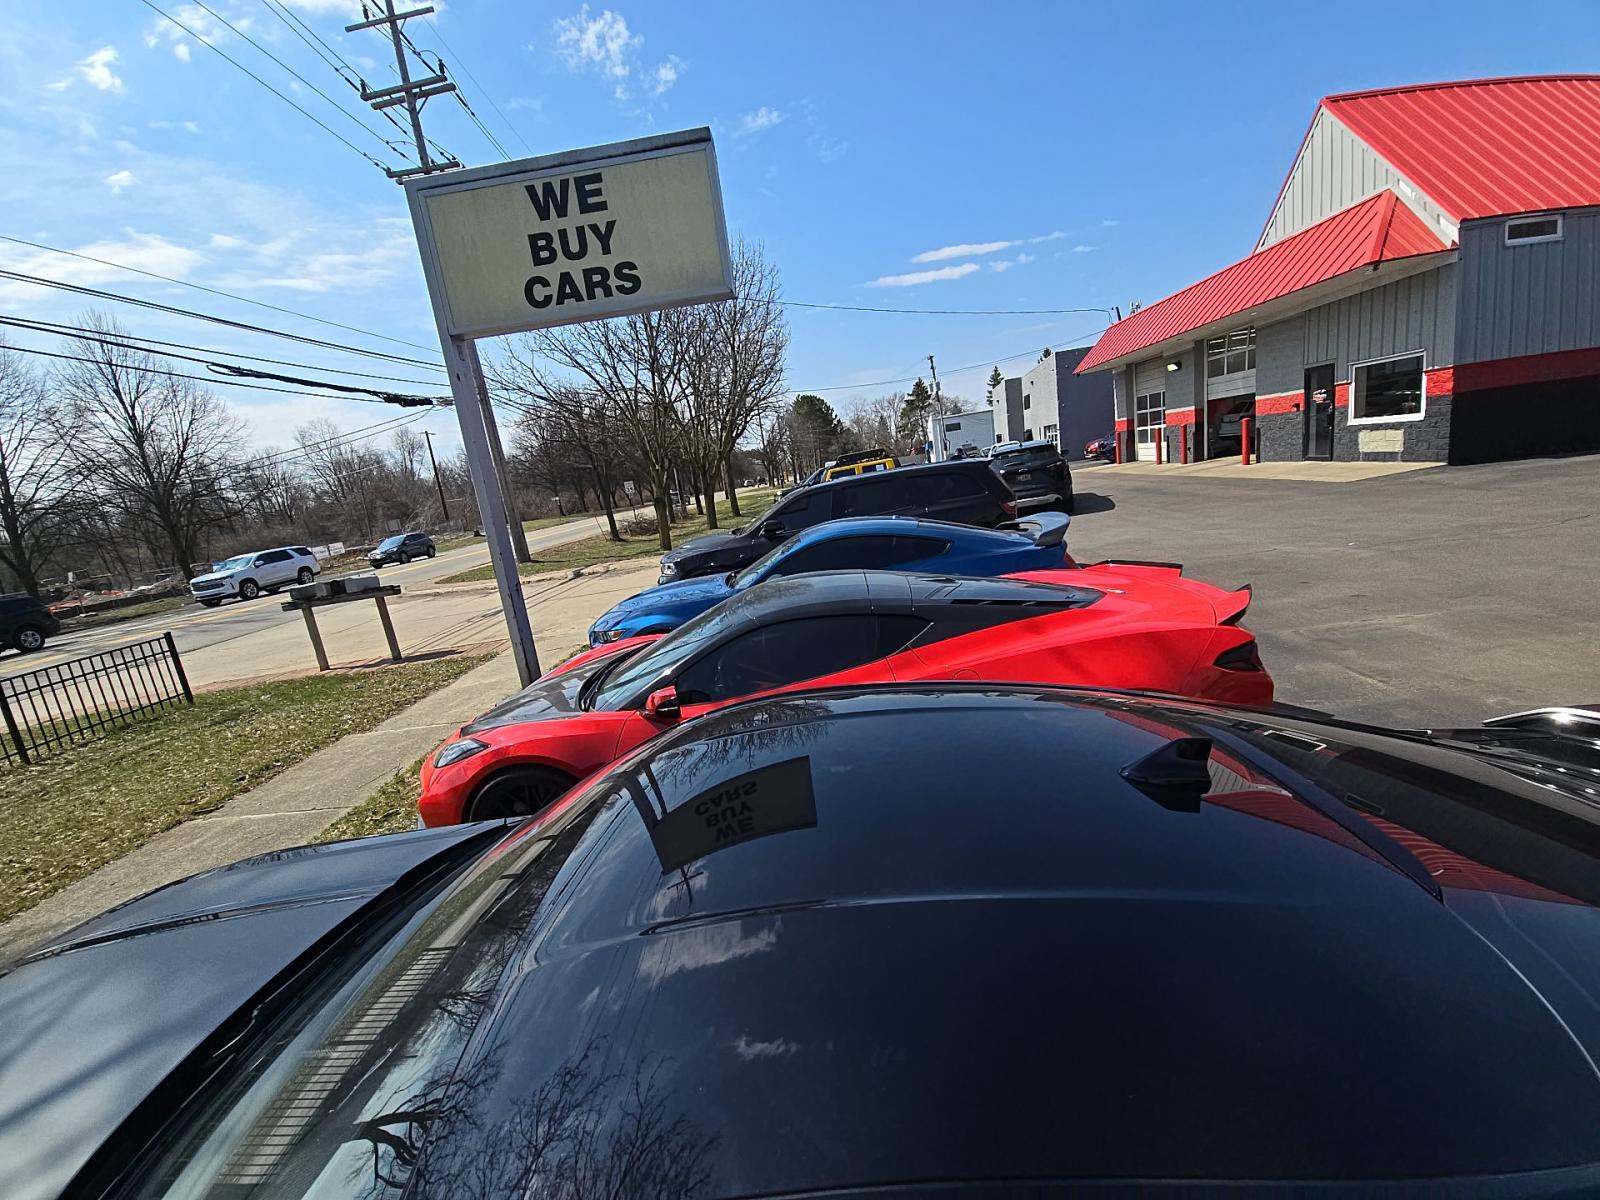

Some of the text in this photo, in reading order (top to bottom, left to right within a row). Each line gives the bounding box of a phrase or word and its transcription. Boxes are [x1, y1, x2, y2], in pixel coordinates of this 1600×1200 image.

[525, 172, 609, 221] WE
[527, 219, 617, 267] BUY
[523, 261, 642, 309] CARS
